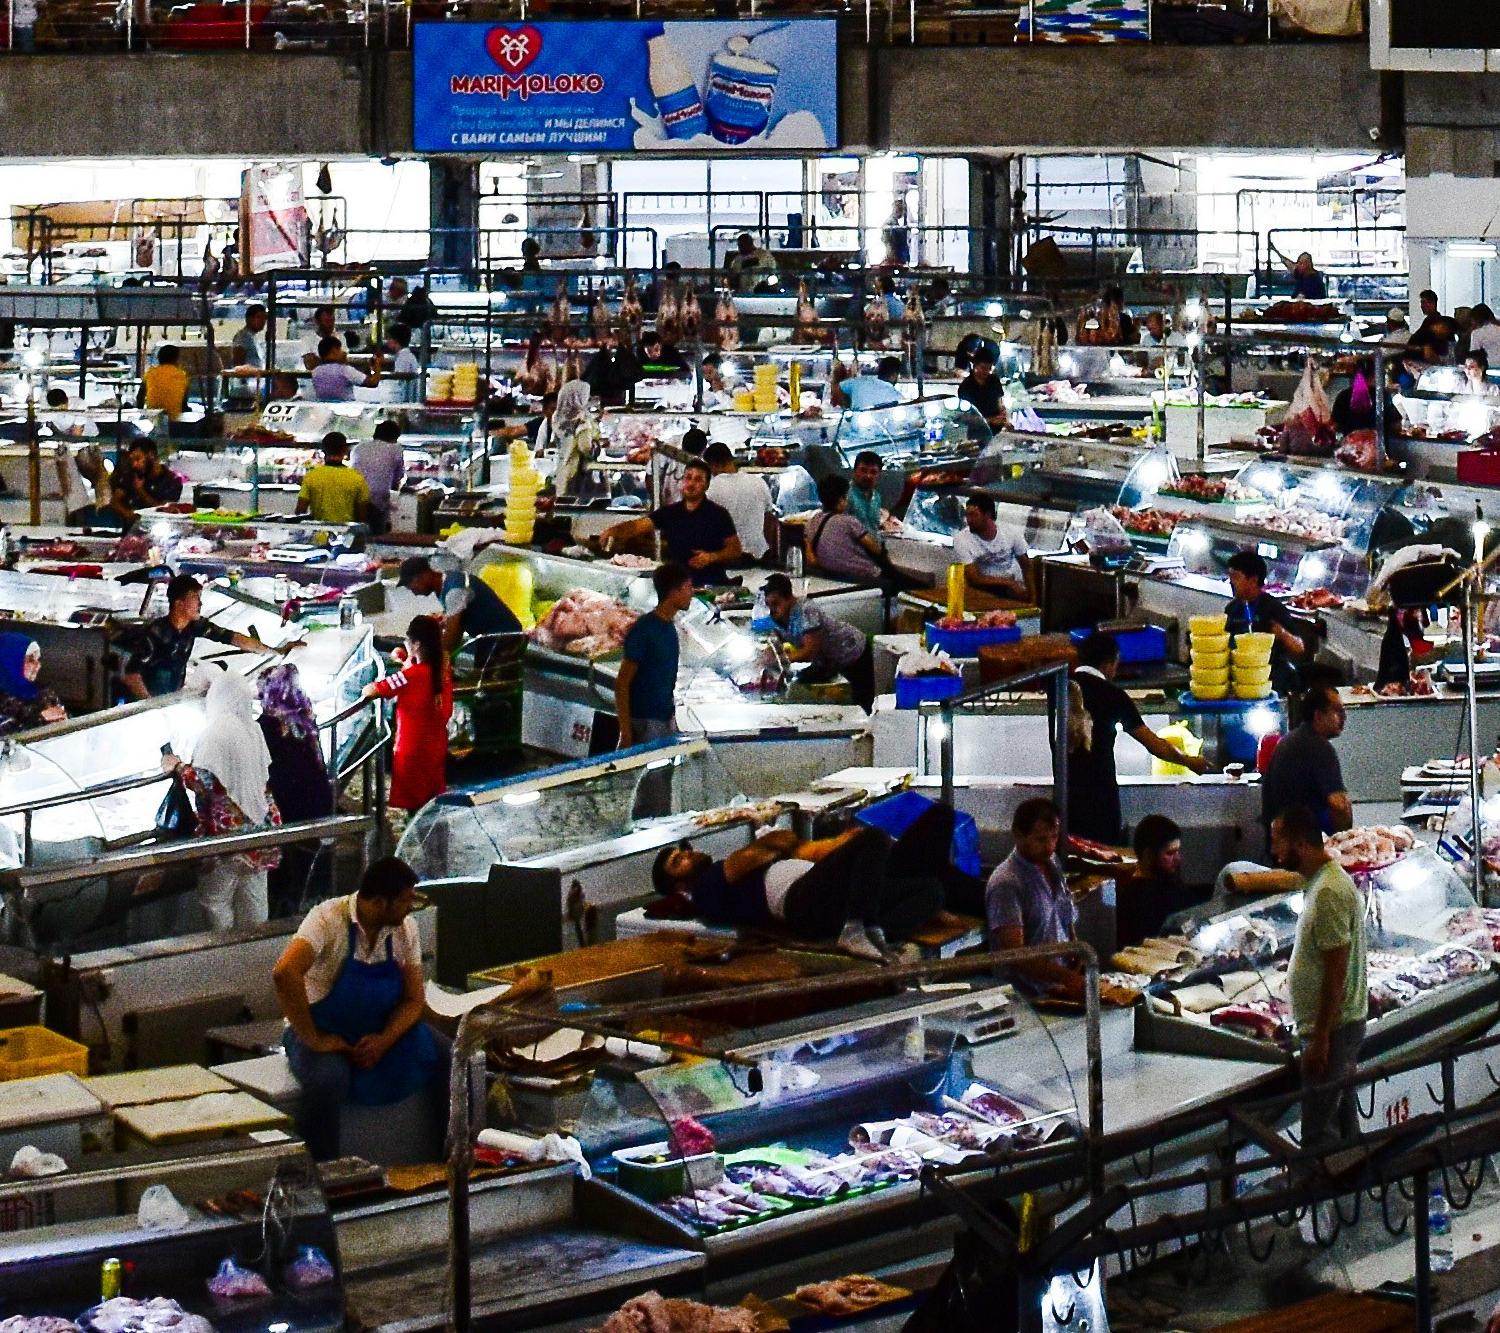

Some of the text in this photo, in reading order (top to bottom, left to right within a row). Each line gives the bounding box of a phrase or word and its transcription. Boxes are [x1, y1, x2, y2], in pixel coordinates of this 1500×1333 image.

[554, 119, 572, 128] МЫ
[574, 118, 626, 129] ДЕЛИМСЯ
[451, 132, 608, 144] С ВАМИ САМЫМ ЛУЧШИМ!
[268, 405, 295, 414] ОТ
